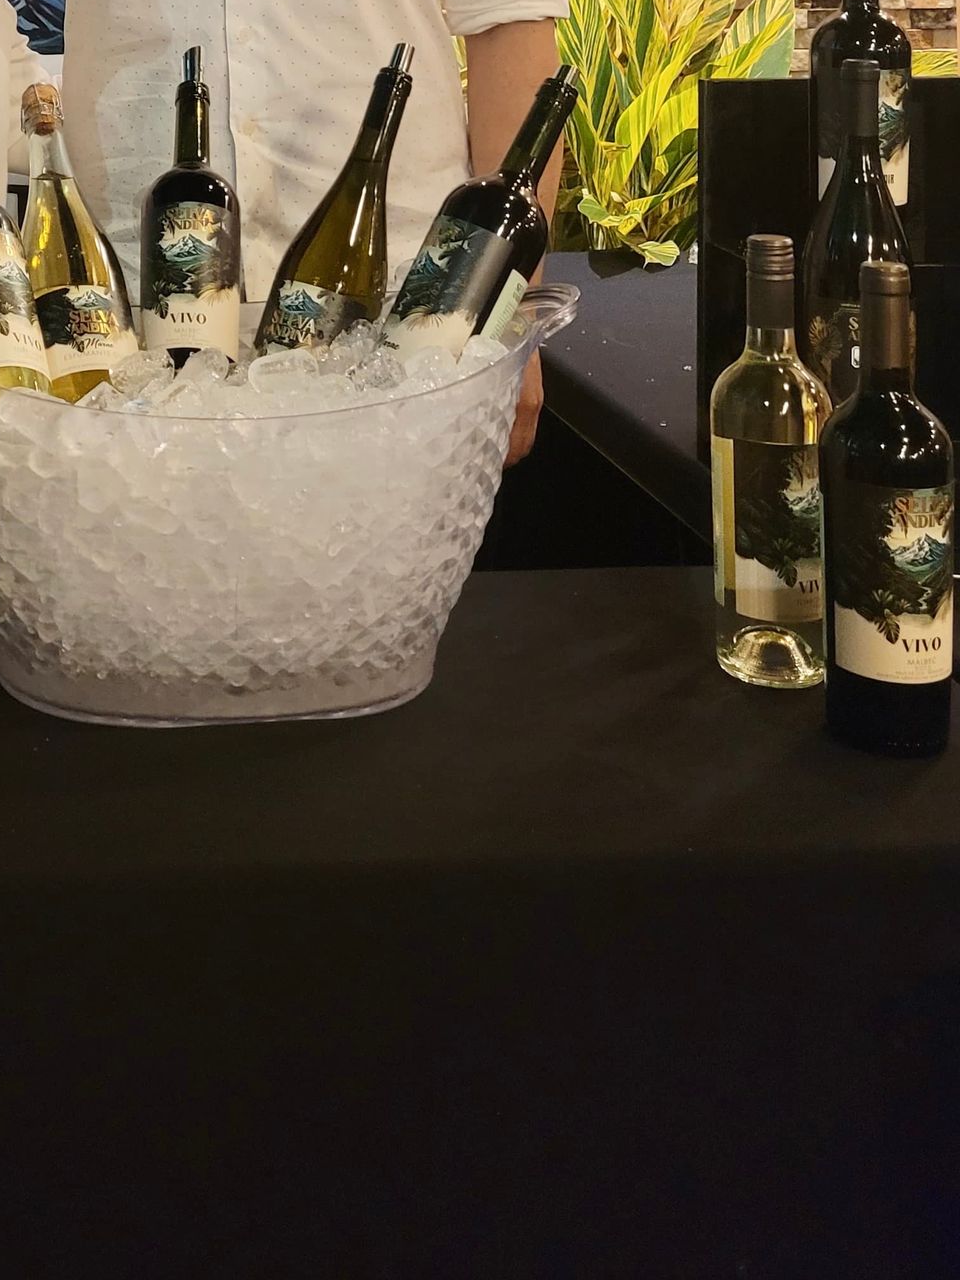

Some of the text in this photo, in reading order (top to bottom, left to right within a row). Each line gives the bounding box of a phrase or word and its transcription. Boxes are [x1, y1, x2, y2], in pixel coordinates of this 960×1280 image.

[170, 313, 207, 325] VIVO
[12, 331, 42, 351] VIVO
[902, 637, 941, 653] VIVO
